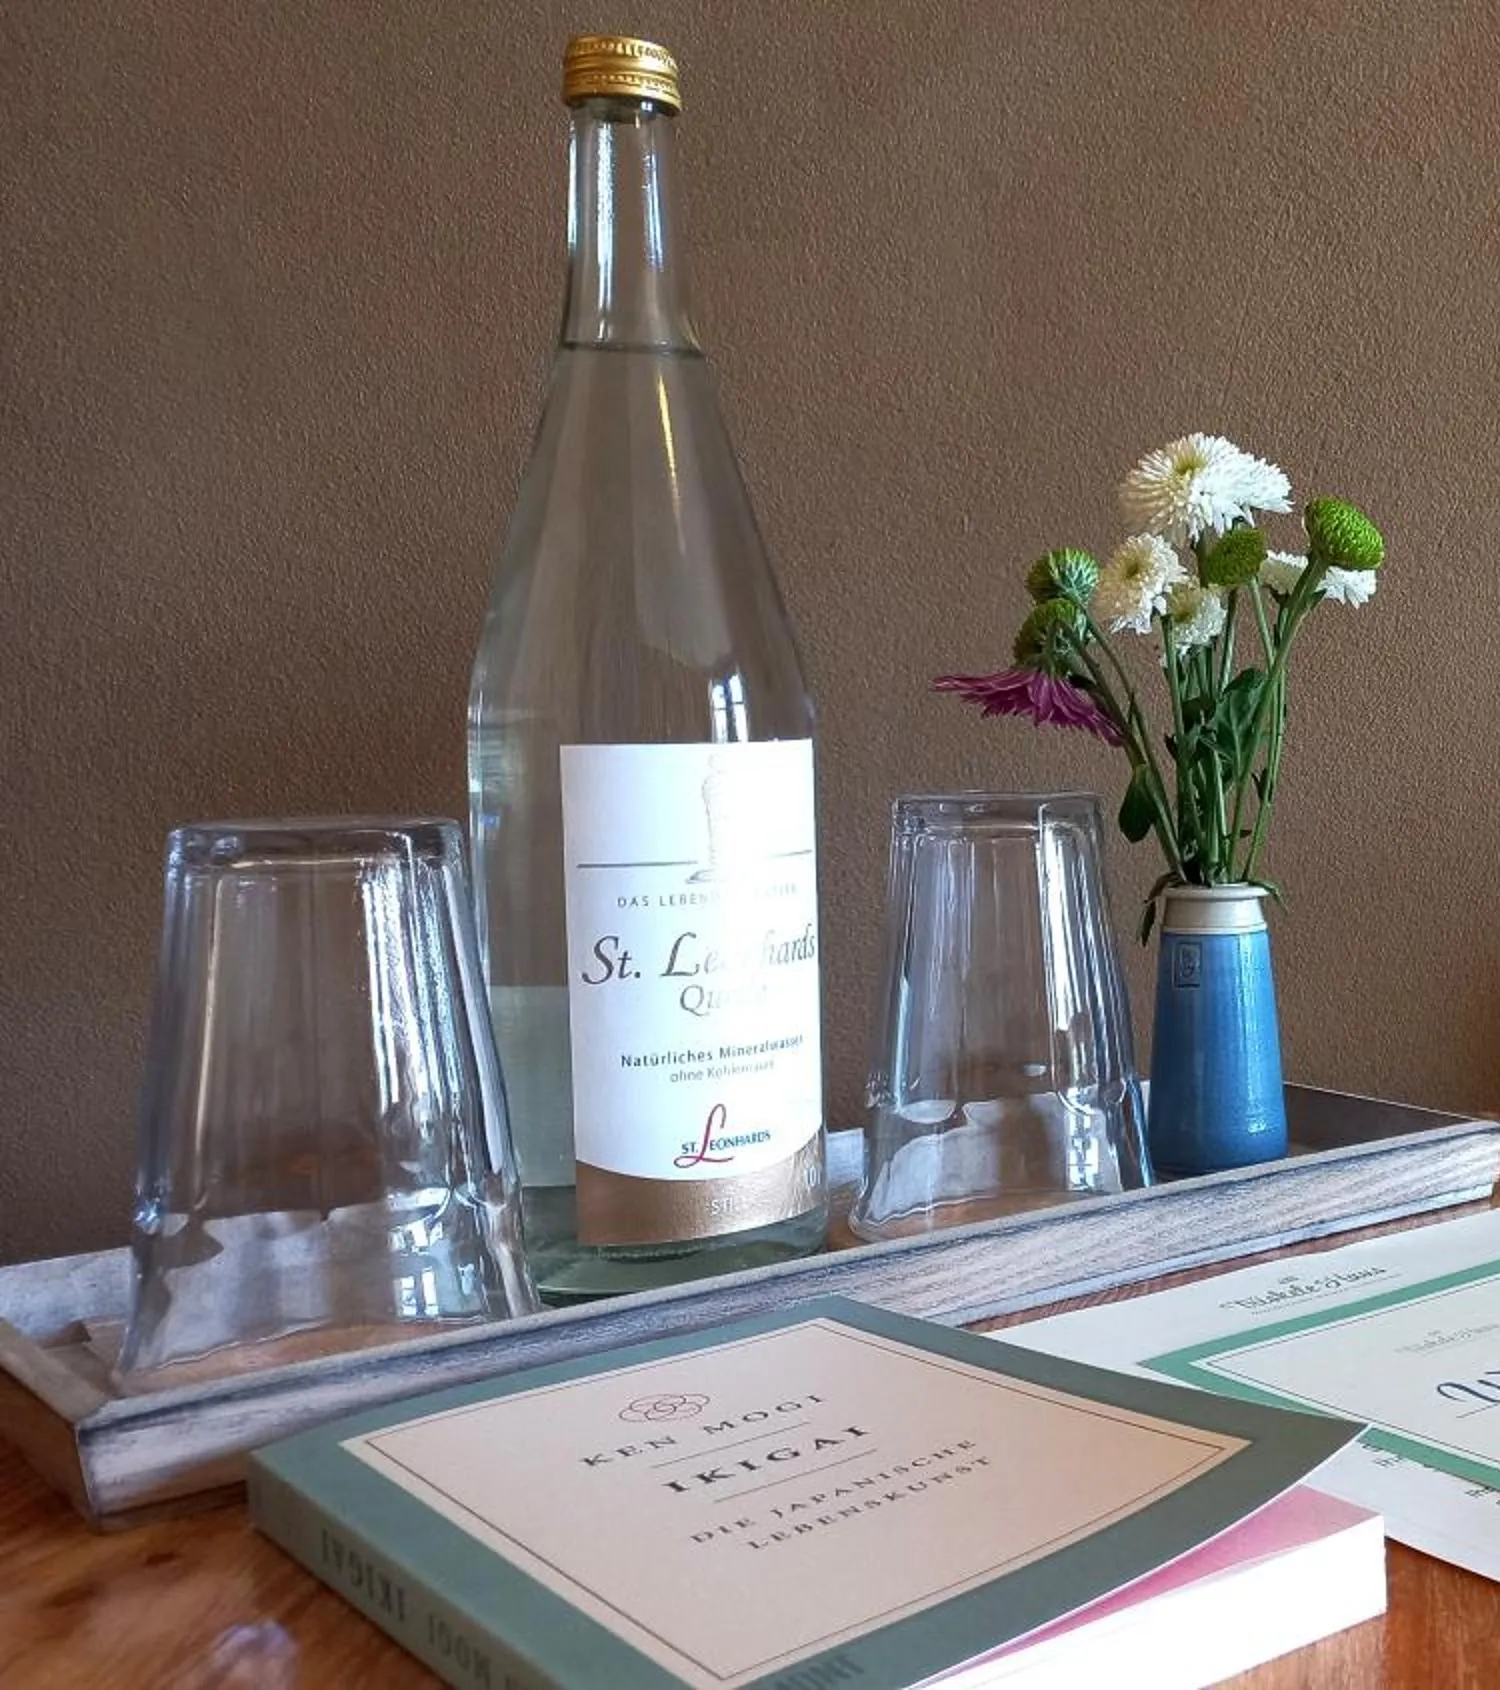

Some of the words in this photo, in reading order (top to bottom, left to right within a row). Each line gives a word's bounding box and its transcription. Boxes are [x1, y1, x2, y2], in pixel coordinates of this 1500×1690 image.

[617, 895, 649, 908] DAS
[581, 934, 642, 986] St.
[660, 922, 816, 978] Lehards
[621, 1050, 714, 1069] Natürliches
[669, 1069, 704, 1084] ohne
[580, 1434, 677, 1468] KEN
[702, 1395, 827, 1435] MOGI
[661, 1424, 872, 1494] IKIGAI
[690, 1517, 753, 1544] DIE
[772, 1439, 976, 1520] JAPANISCHE
[745, 1457, 993, 1550] LEBENSKUNST
